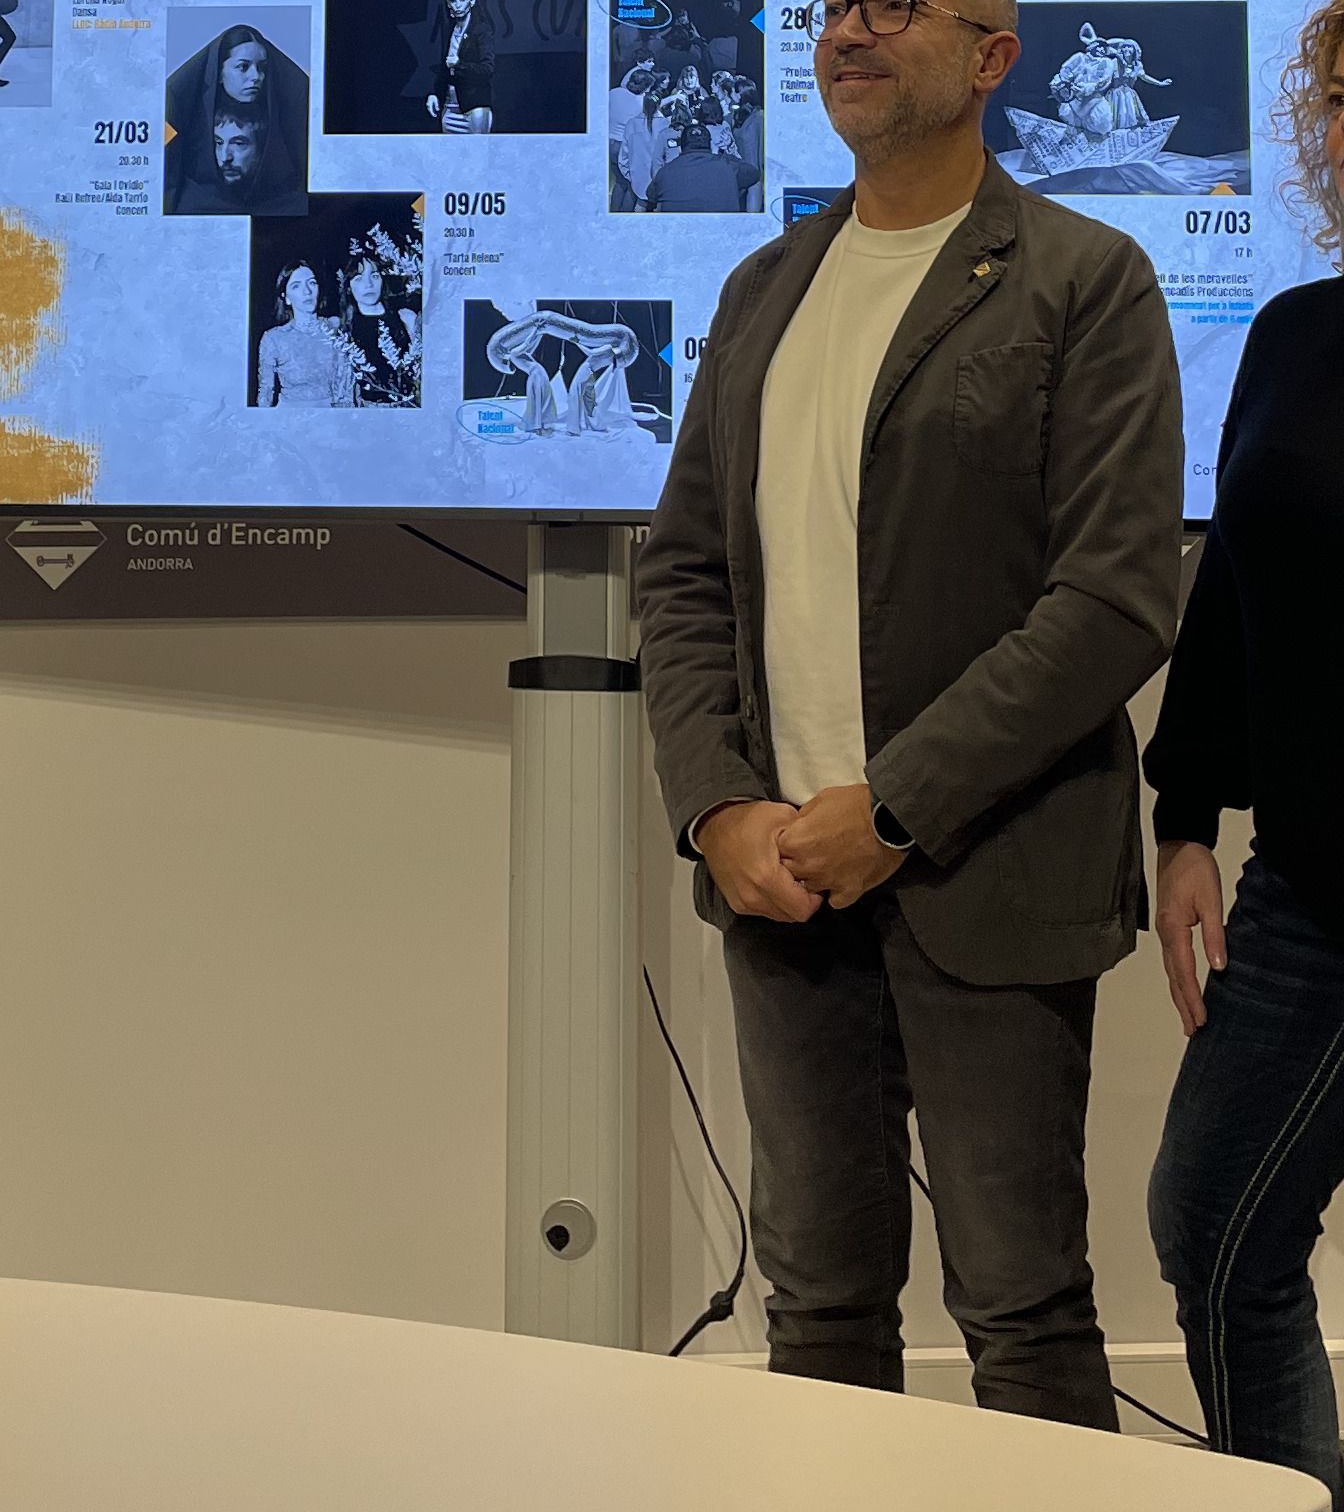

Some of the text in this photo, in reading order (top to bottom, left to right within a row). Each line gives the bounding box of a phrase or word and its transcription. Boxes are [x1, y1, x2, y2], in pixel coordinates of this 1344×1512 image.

[94, 121, 149, 144] 21/03
[444, 192, 505, 216] 09/05
[1185, 210, 1251, 234] 07/03
[127, 522, 331, 550] Comú d'Encamp
[127, 558, 194, 570] ANDORRA
